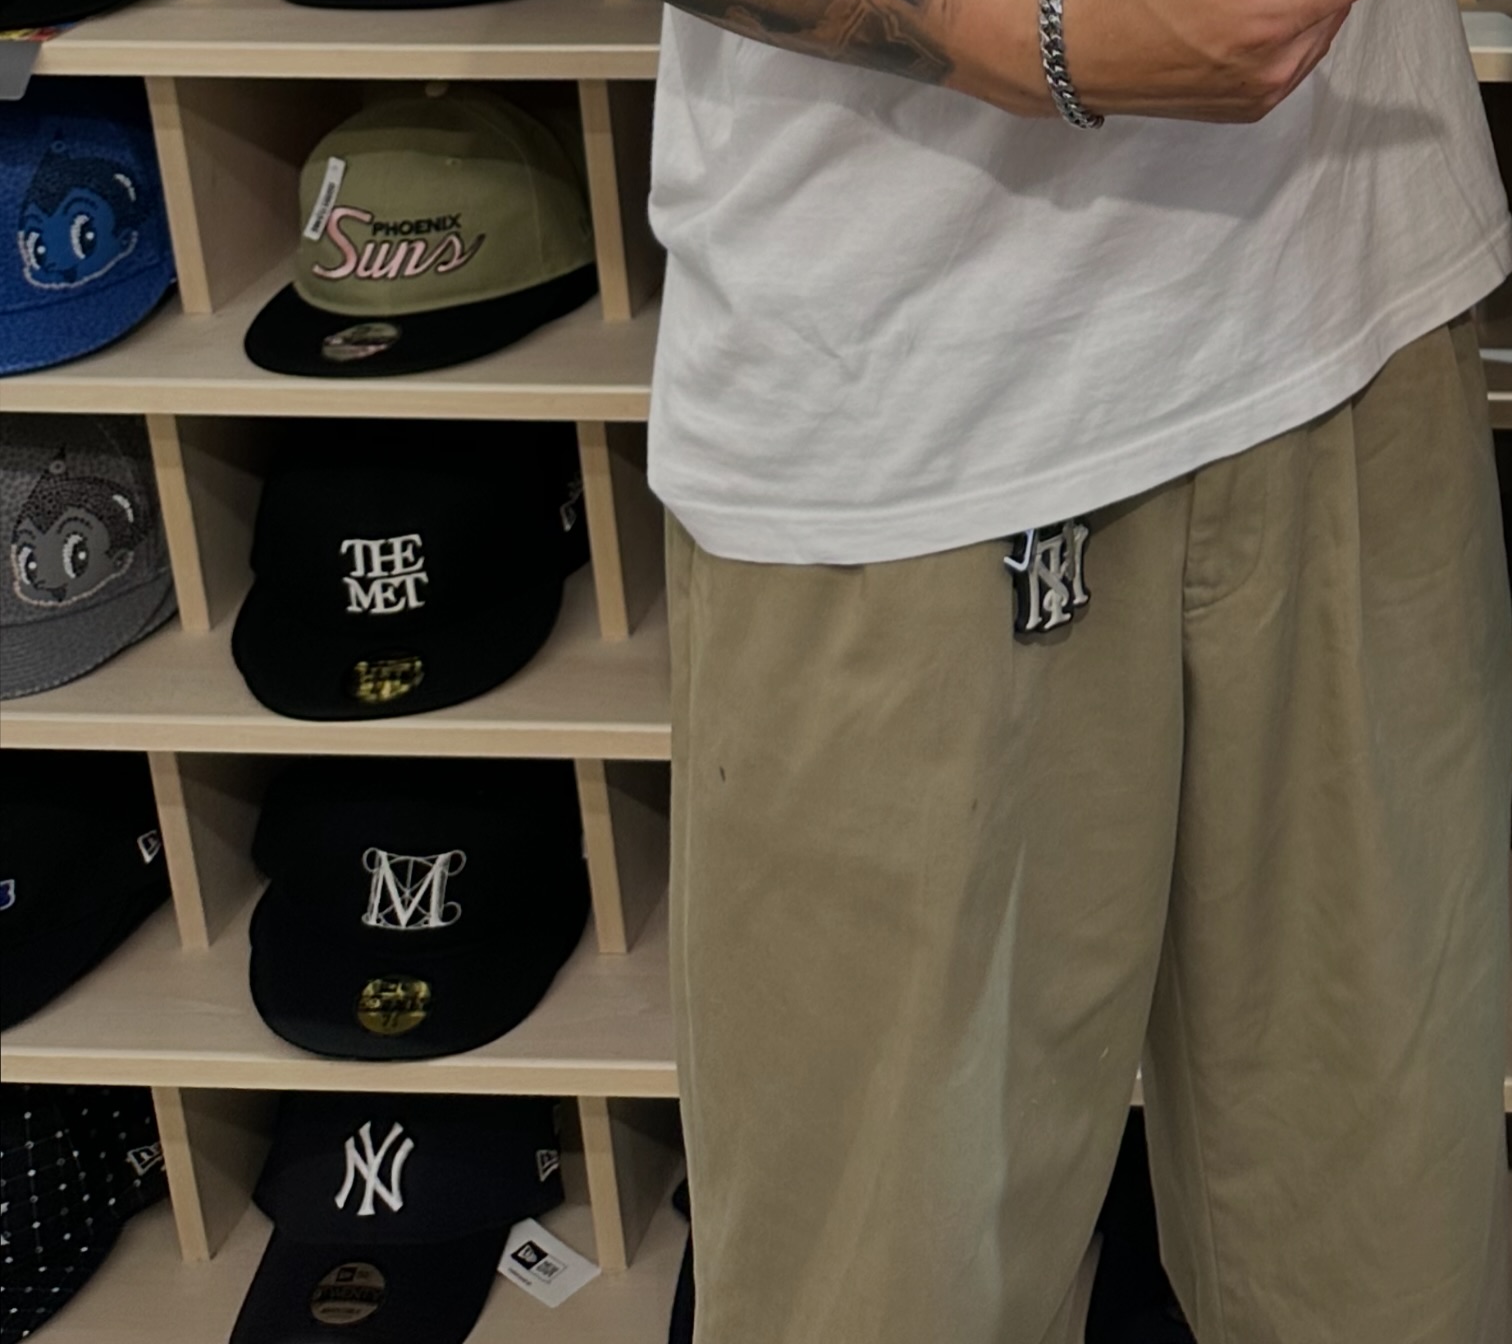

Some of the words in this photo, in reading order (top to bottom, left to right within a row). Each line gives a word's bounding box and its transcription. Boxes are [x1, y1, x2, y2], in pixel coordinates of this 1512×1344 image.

[312, 205, 487, 281] Suns
[371, 213, 462, 238] PHOENIX
[339, 532, 425, 579] THE
[342, 571, 428, 615] MET
[361, 846, 467, 930] M
[334, 1120, 415, 1217] NY
